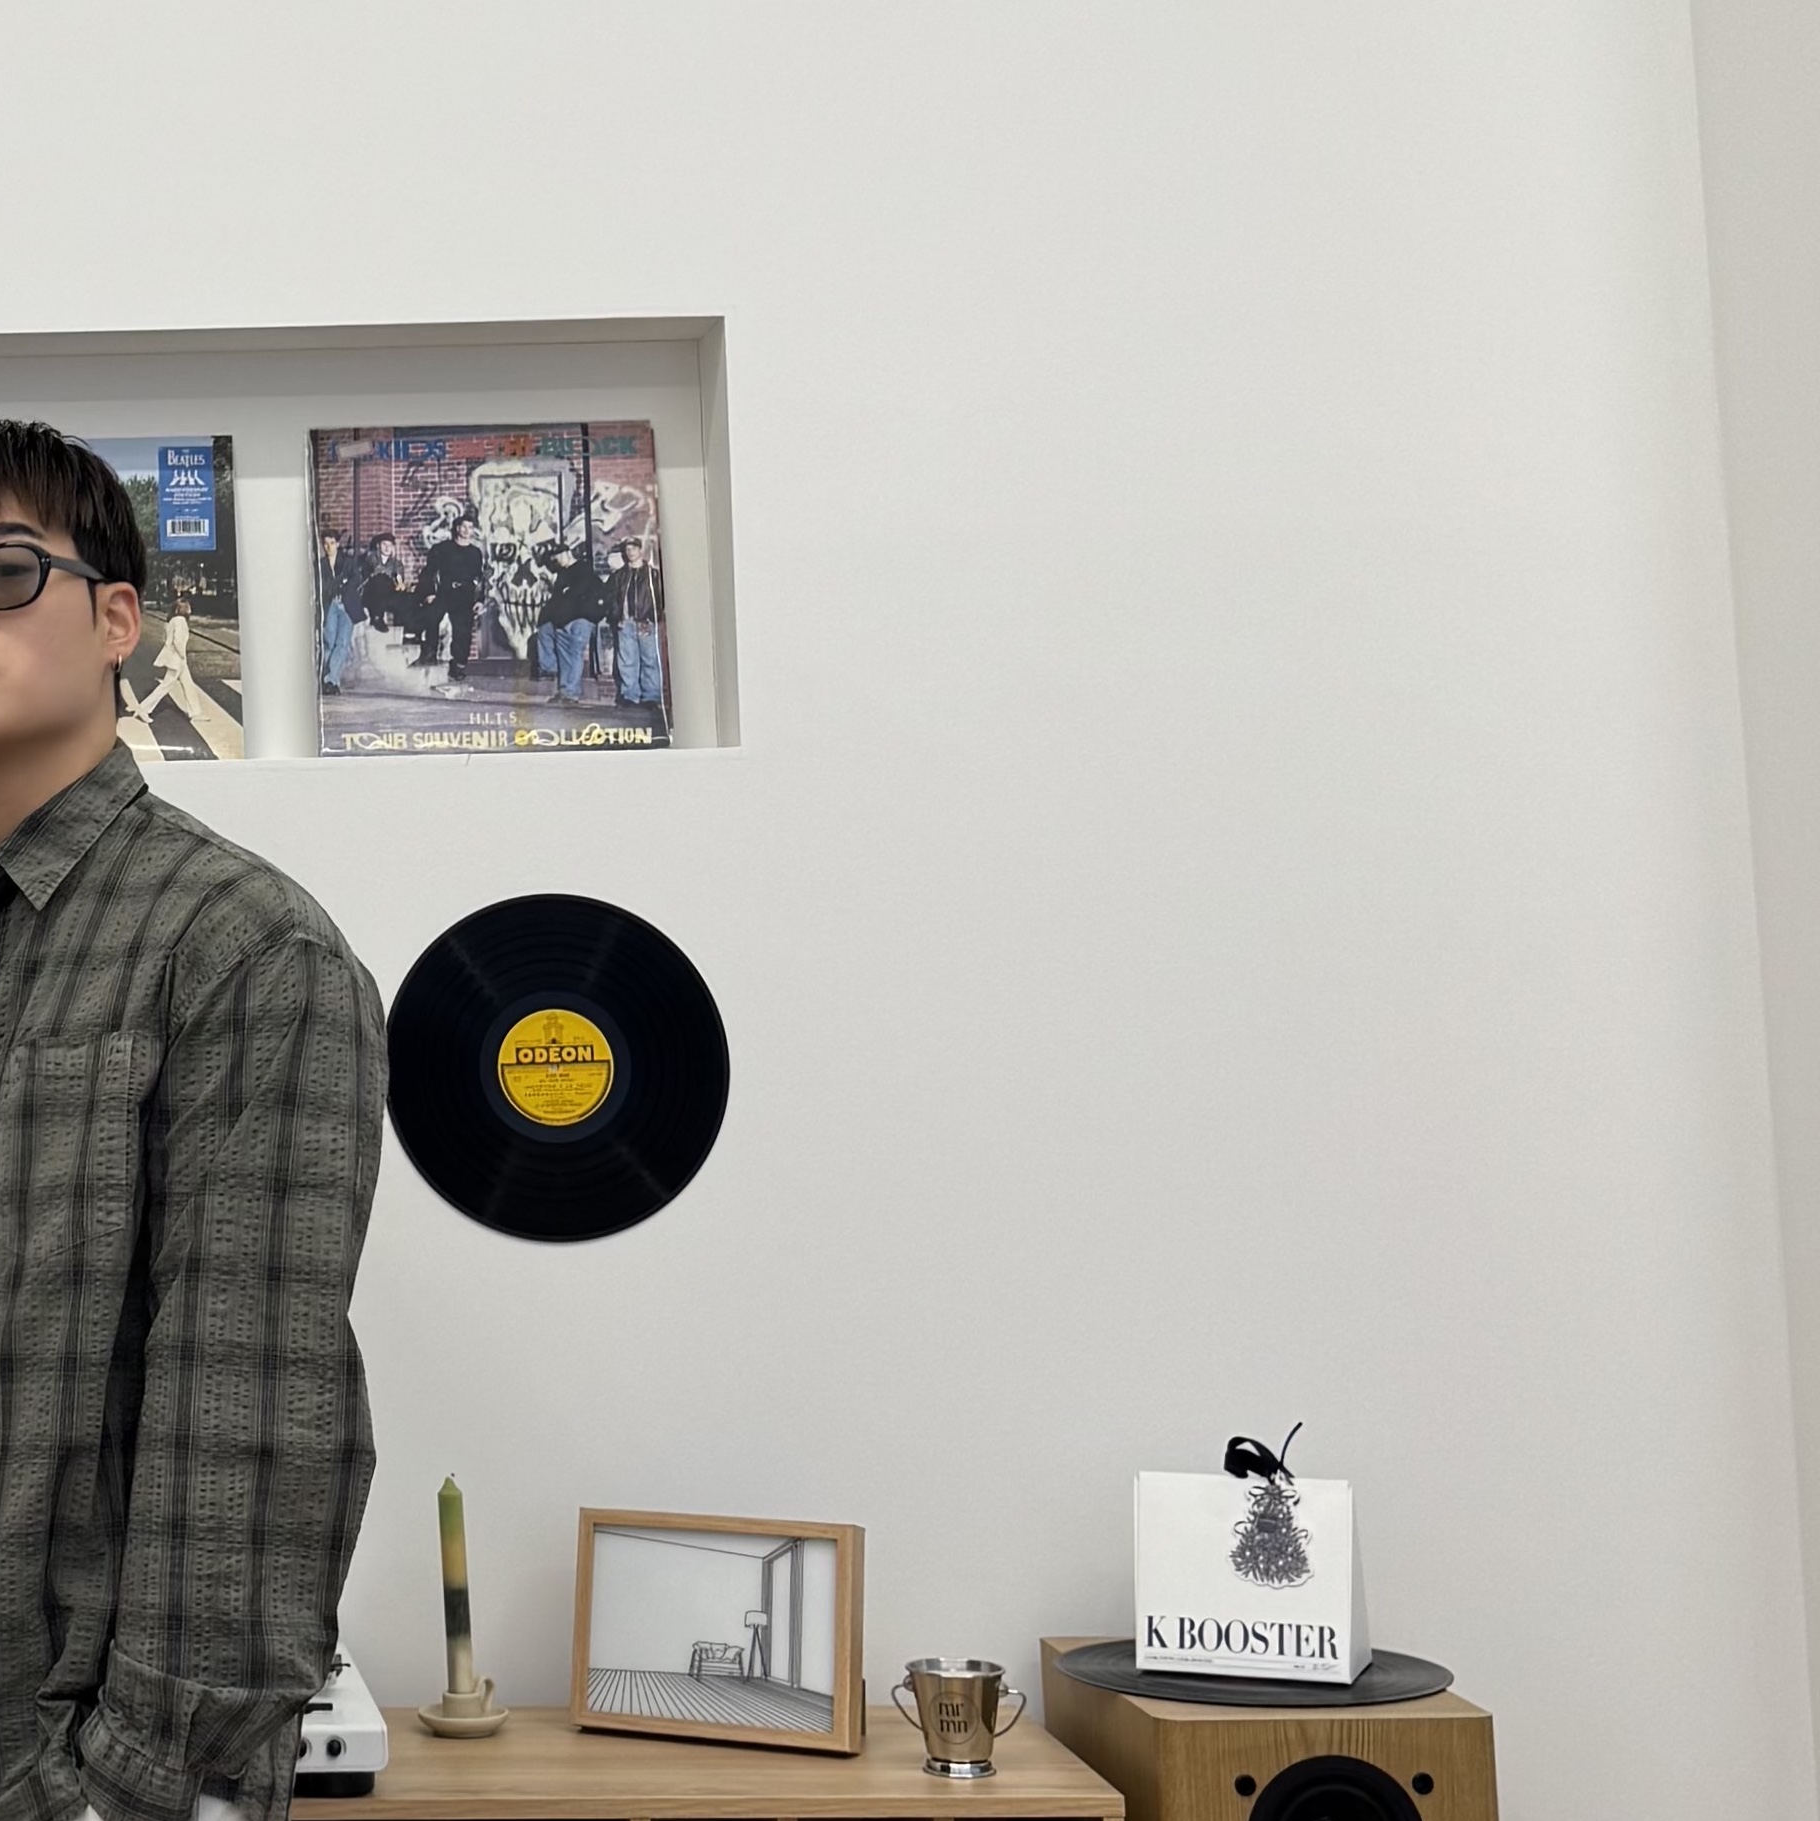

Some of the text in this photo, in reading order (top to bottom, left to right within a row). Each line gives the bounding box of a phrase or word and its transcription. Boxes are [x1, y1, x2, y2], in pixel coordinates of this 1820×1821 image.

[341, 732, 407, 750] TOUR
[413, 730, 508, 749] SOUVENIR
[517, 1046, 592, 1064] ODEON
[1145, 1615, 1339, 1660] K BOOSTER
